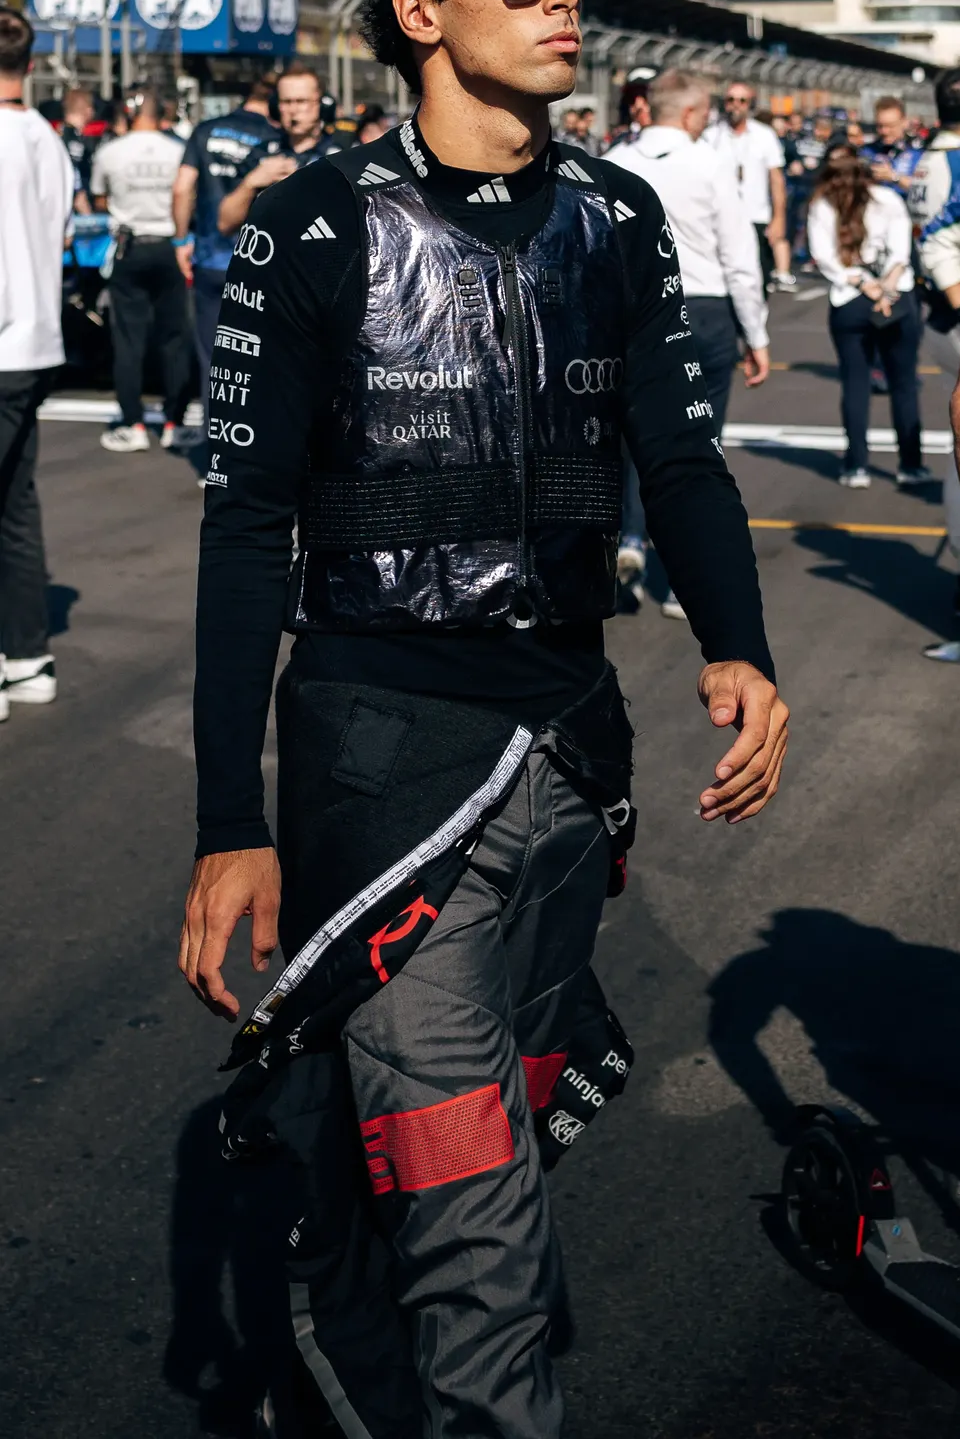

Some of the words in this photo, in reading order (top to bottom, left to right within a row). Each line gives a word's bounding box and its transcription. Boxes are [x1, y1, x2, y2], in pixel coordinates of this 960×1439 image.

[222, 281, 265, 312] evolut
[235, 371, 252, 386] OF
[367, 364, 473, 390] Revolut
[210, 380, 251, 406] YATT
[410, 410, 451, 424] visit
[392, 425, 452, 442] QATAR
